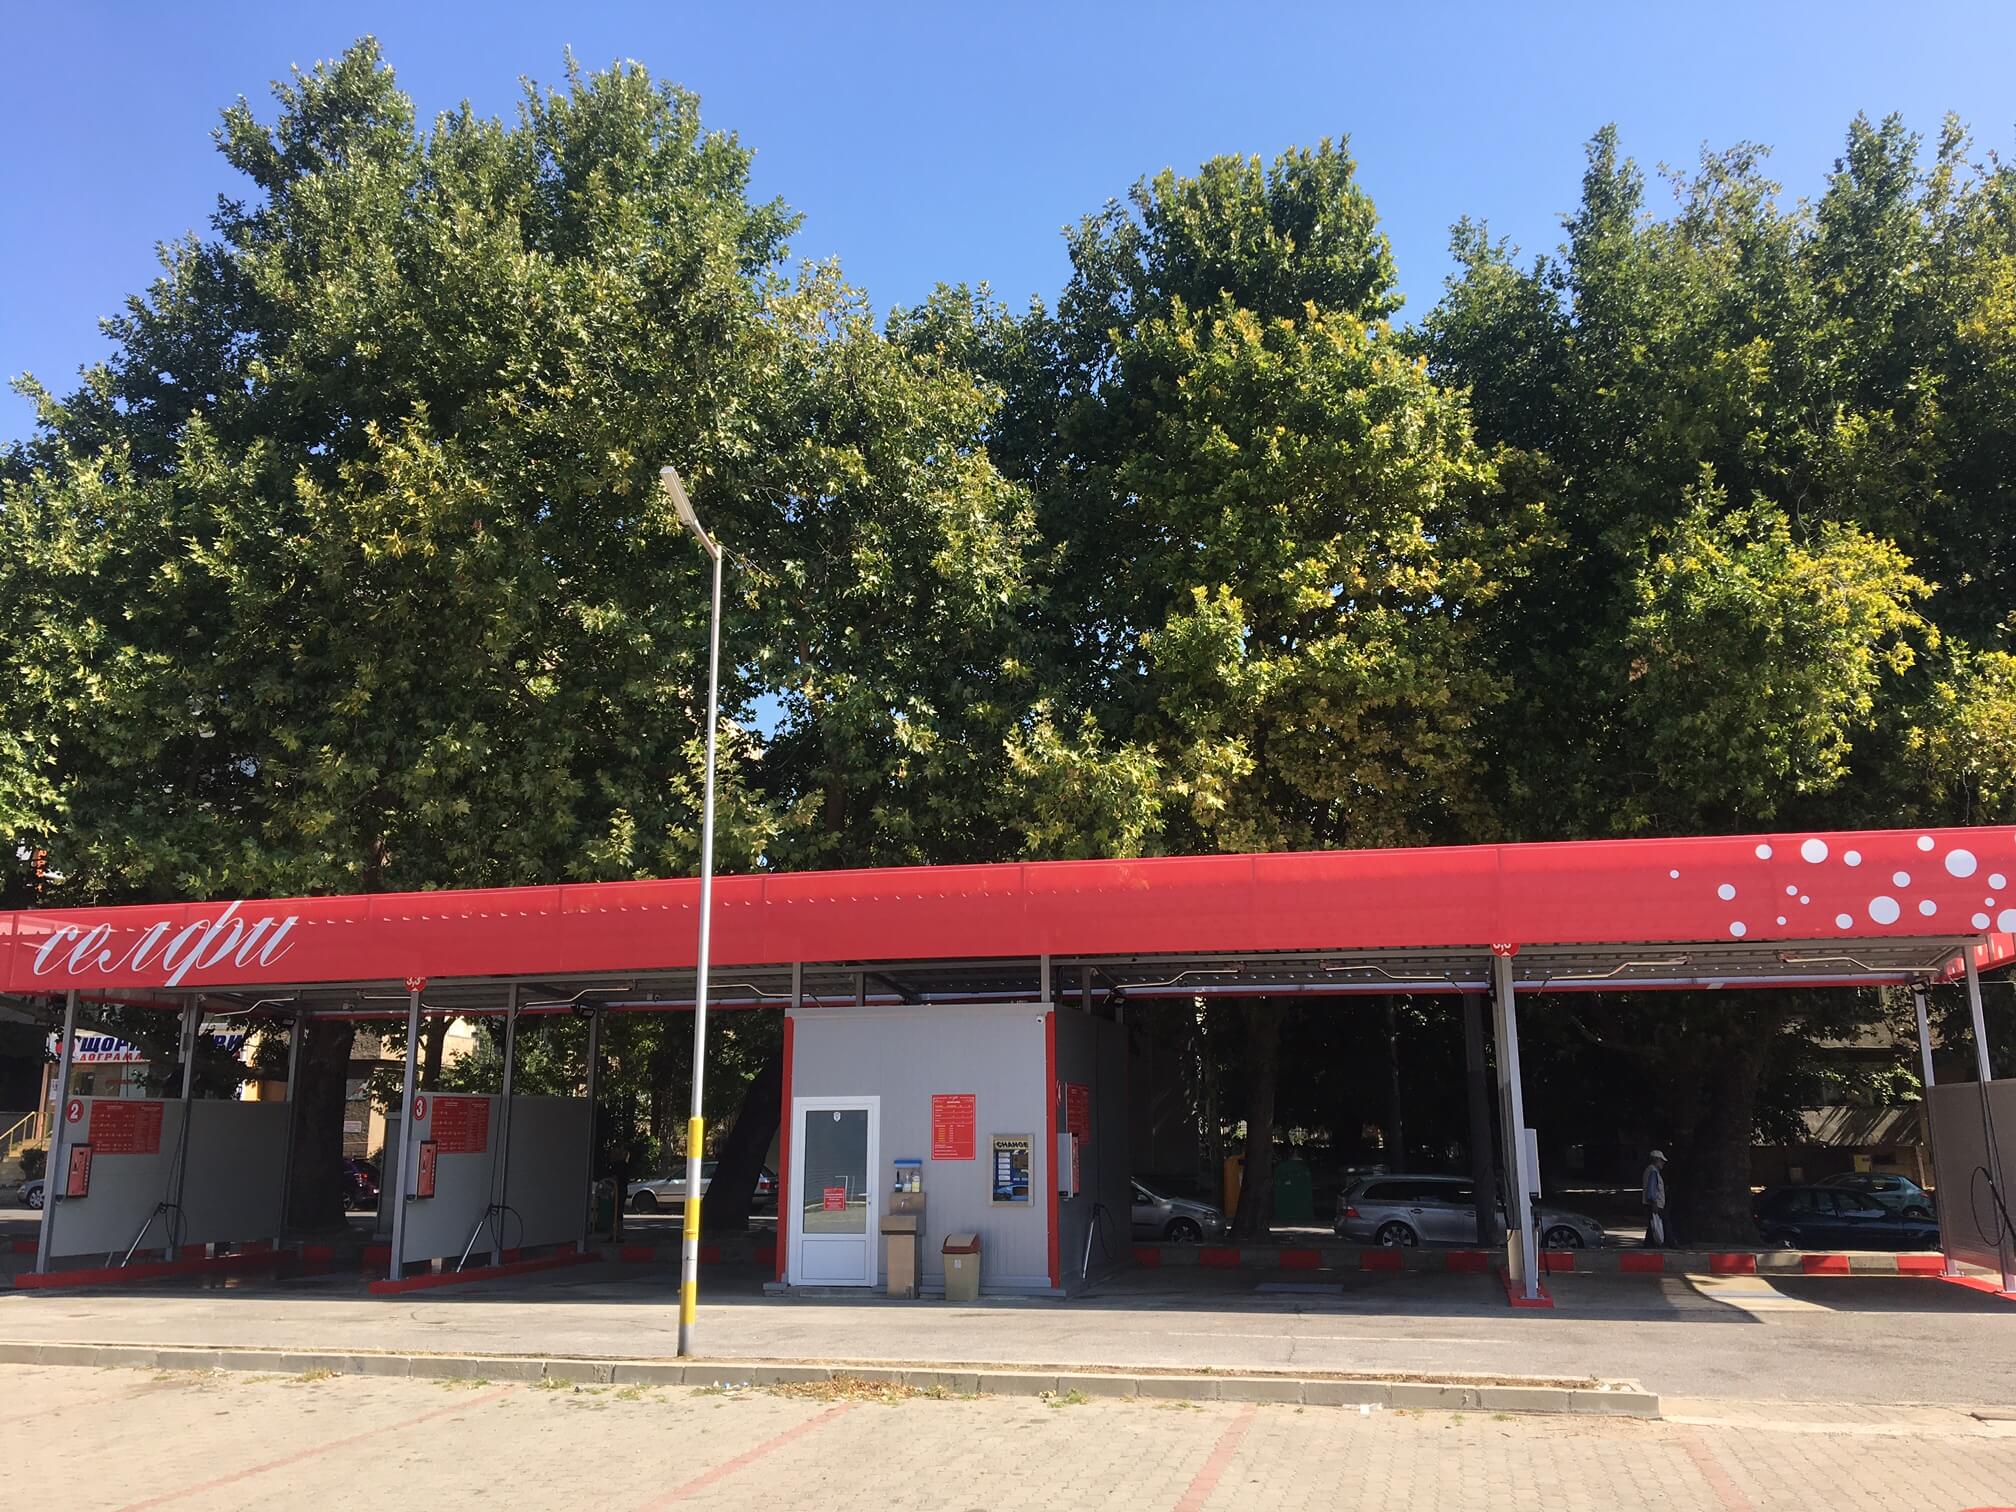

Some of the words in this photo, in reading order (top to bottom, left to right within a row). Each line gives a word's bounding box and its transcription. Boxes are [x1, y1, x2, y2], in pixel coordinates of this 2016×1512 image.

[34, 900, 299, 987] селфи
[70, 1103, 79, 1120] 2
[416, 1099, 424, 1117] 3
[996, 1140, 1029, 1149] CHANGE
